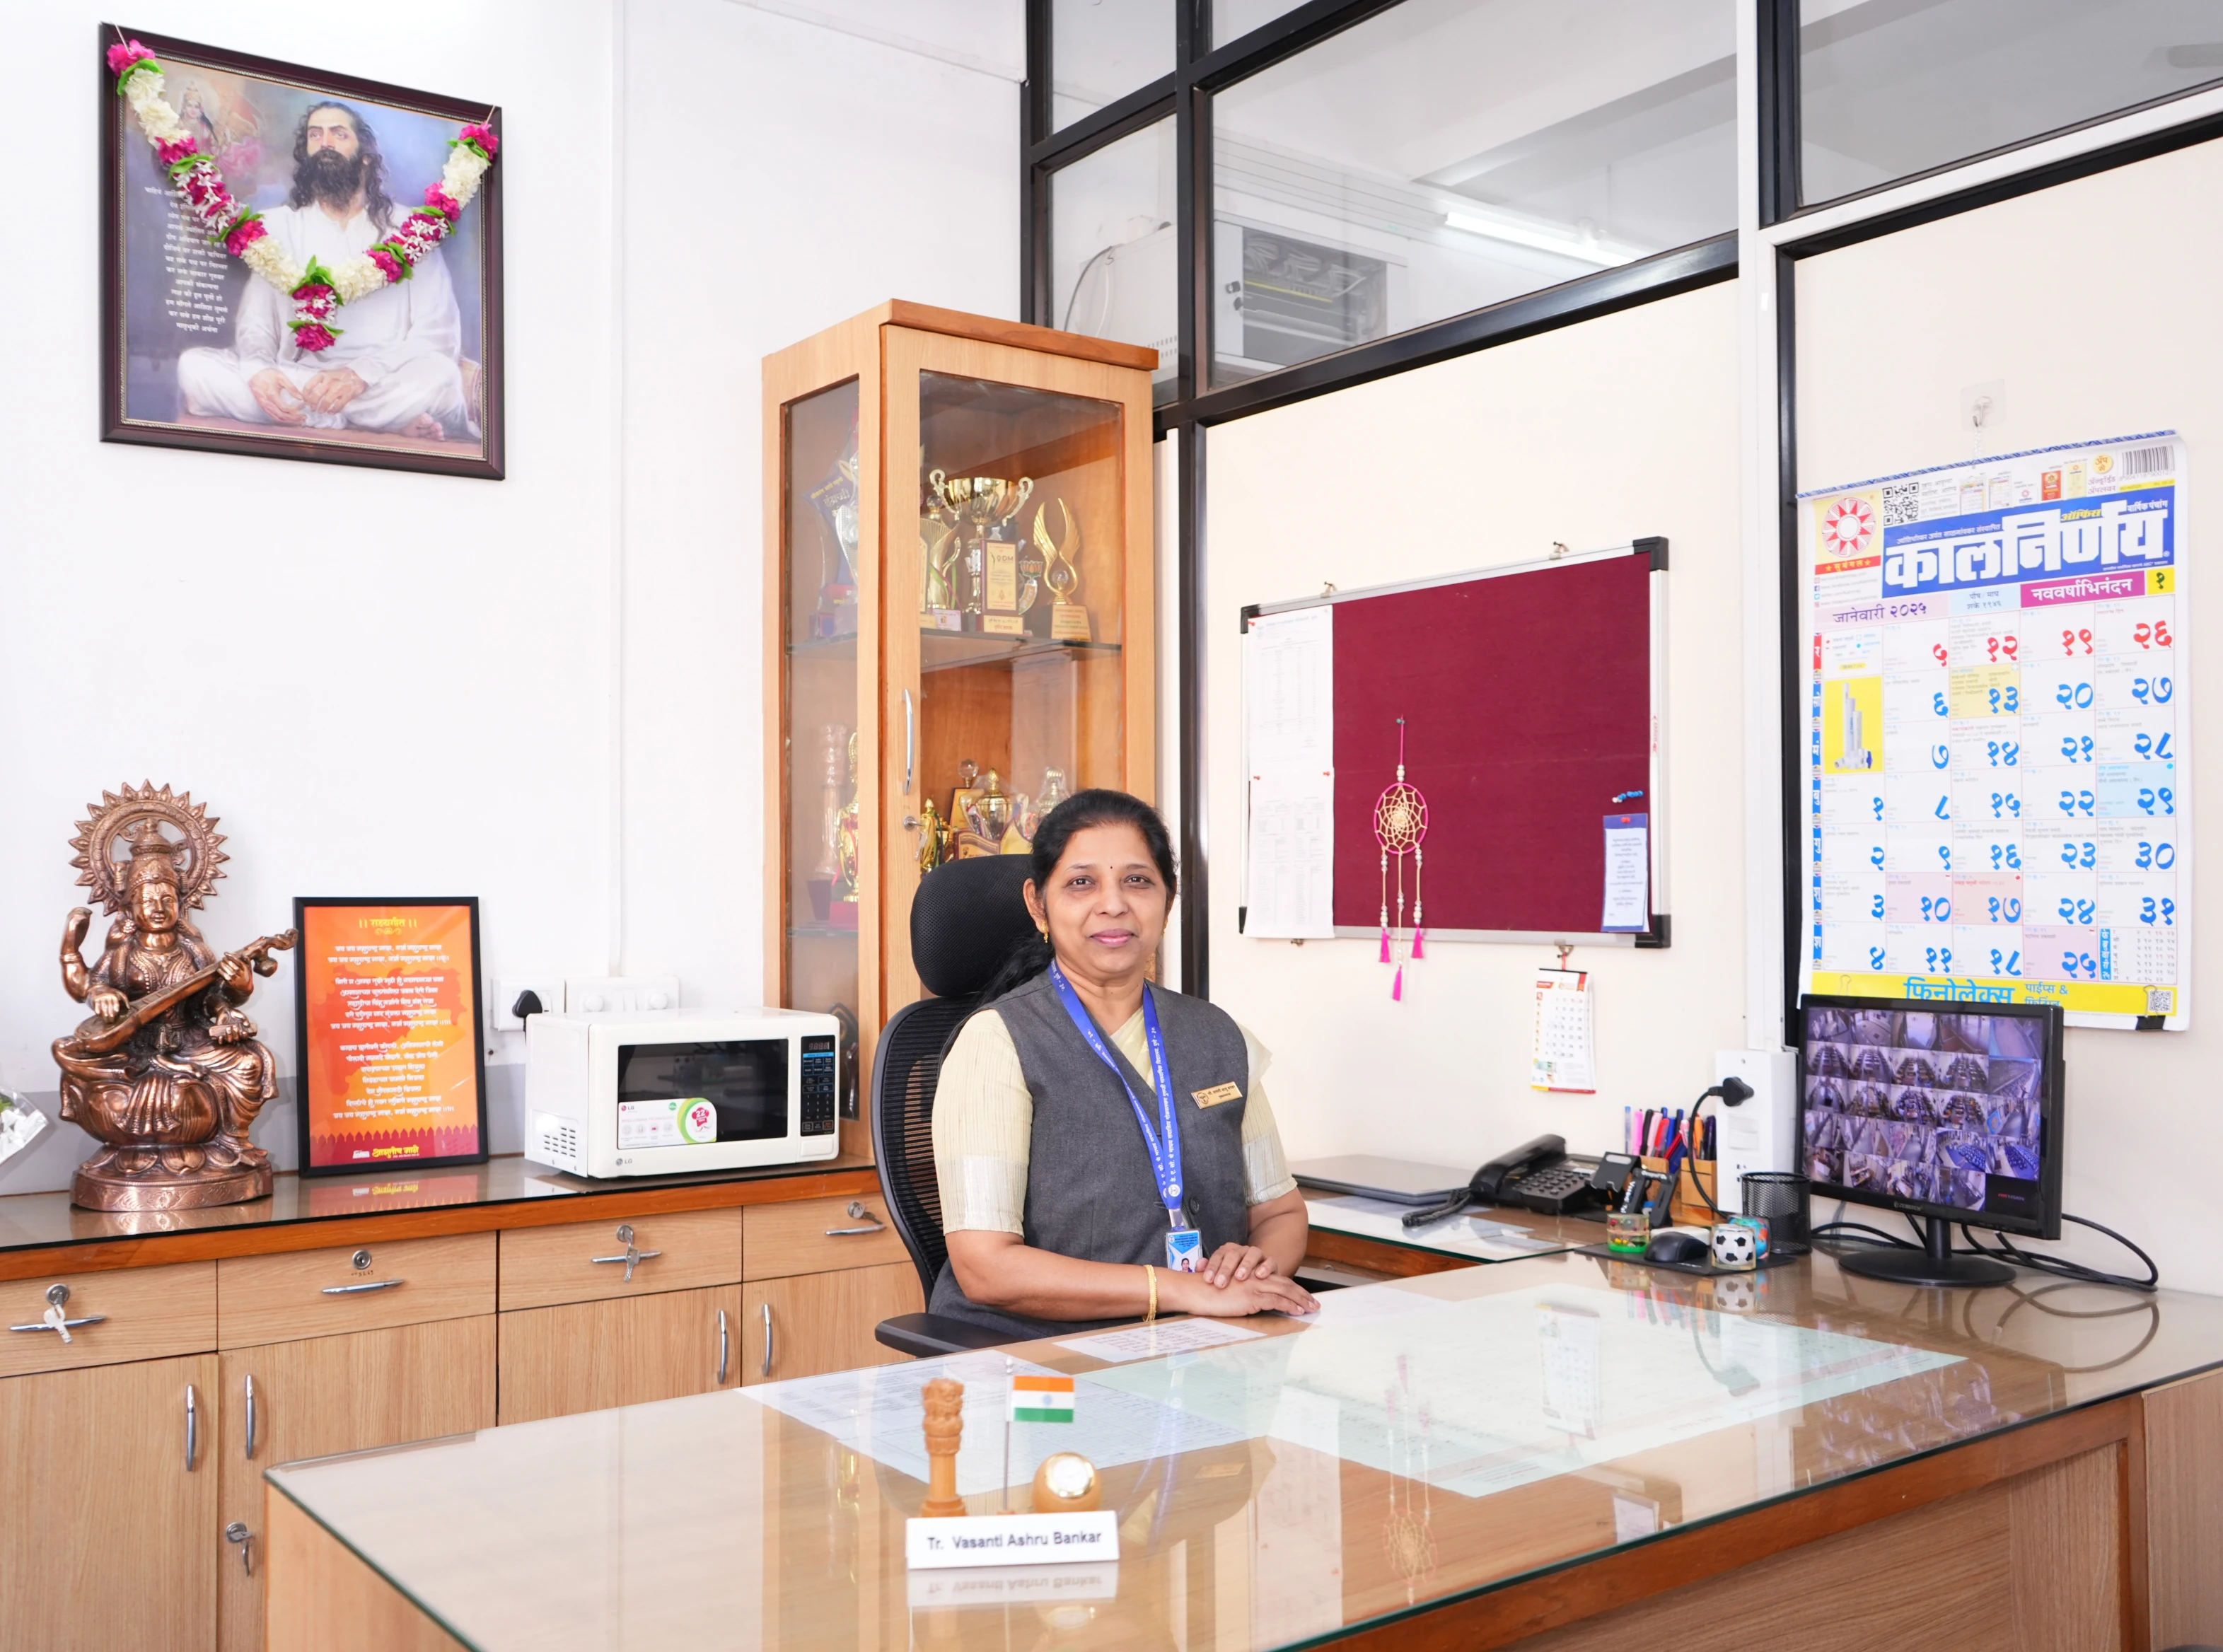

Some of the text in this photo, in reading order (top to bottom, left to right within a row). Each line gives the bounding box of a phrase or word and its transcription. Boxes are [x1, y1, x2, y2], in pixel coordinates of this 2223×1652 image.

[2060, 508, 2102, 521] ऑफिस
[1885, 500, 2169, 588] कालनिर्णय
[2031, 578, 2132, 603] नववर्षाभिनंदन
[2157, 573, 2164, 589] १
[1833, 602, 1927, 623] जानेवारी २०२५
[1934, 621, 2172, 666] ५ १२ १९ २६
[1934, 677, 2172, 716] ६ १३ २० २७
[1934, 733, 2173, 769] ७ १४ २१ २८
[1874, 787, 2174, 820] १ ८ १५ २२ २९
[1871, 842, 2174, 871] २ ९ १६ २३ ३०
[1871, 895, 2174, 925] ३ १० १७ २४ ३१
[1870, 947, 1885, 970] ४
[1927, 948, 1952, 972] ११
[1991, 949, 2021, 976] १८
[2062, 952, 2096, 978] २५
[2059, 984, 2068, 994] &
[927, 1530, 1101, 1550] Tr. Vasanti Ashru Bankar
